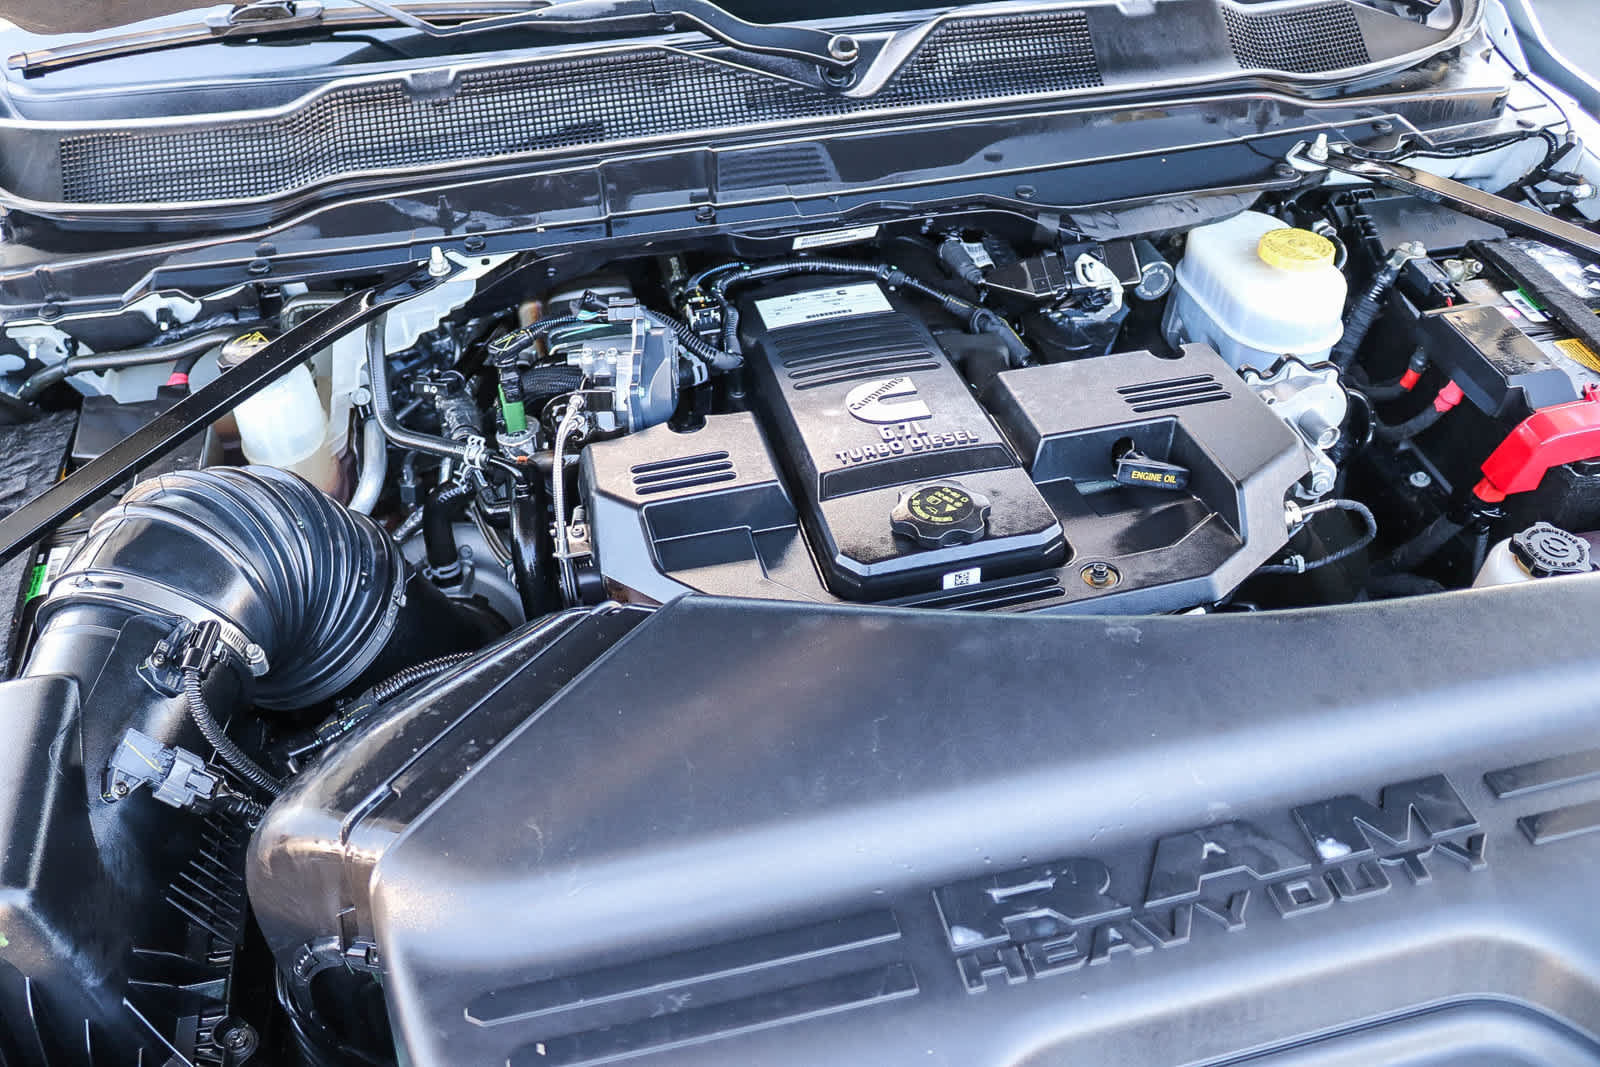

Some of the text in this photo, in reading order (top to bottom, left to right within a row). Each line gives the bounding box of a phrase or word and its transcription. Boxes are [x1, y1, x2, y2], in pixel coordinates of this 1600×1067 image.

[849, 376, 904, 411] Cummins
[836, 430, 979, 464] TURBO DIESEL
[879, 421, 928, 443] 6.7L
[1131, 470, 1176, 484] ENGINE OIL
[932, 773, 1480, 951] RAM
[957, 832, 1488, 993] HEAVY DUTY
